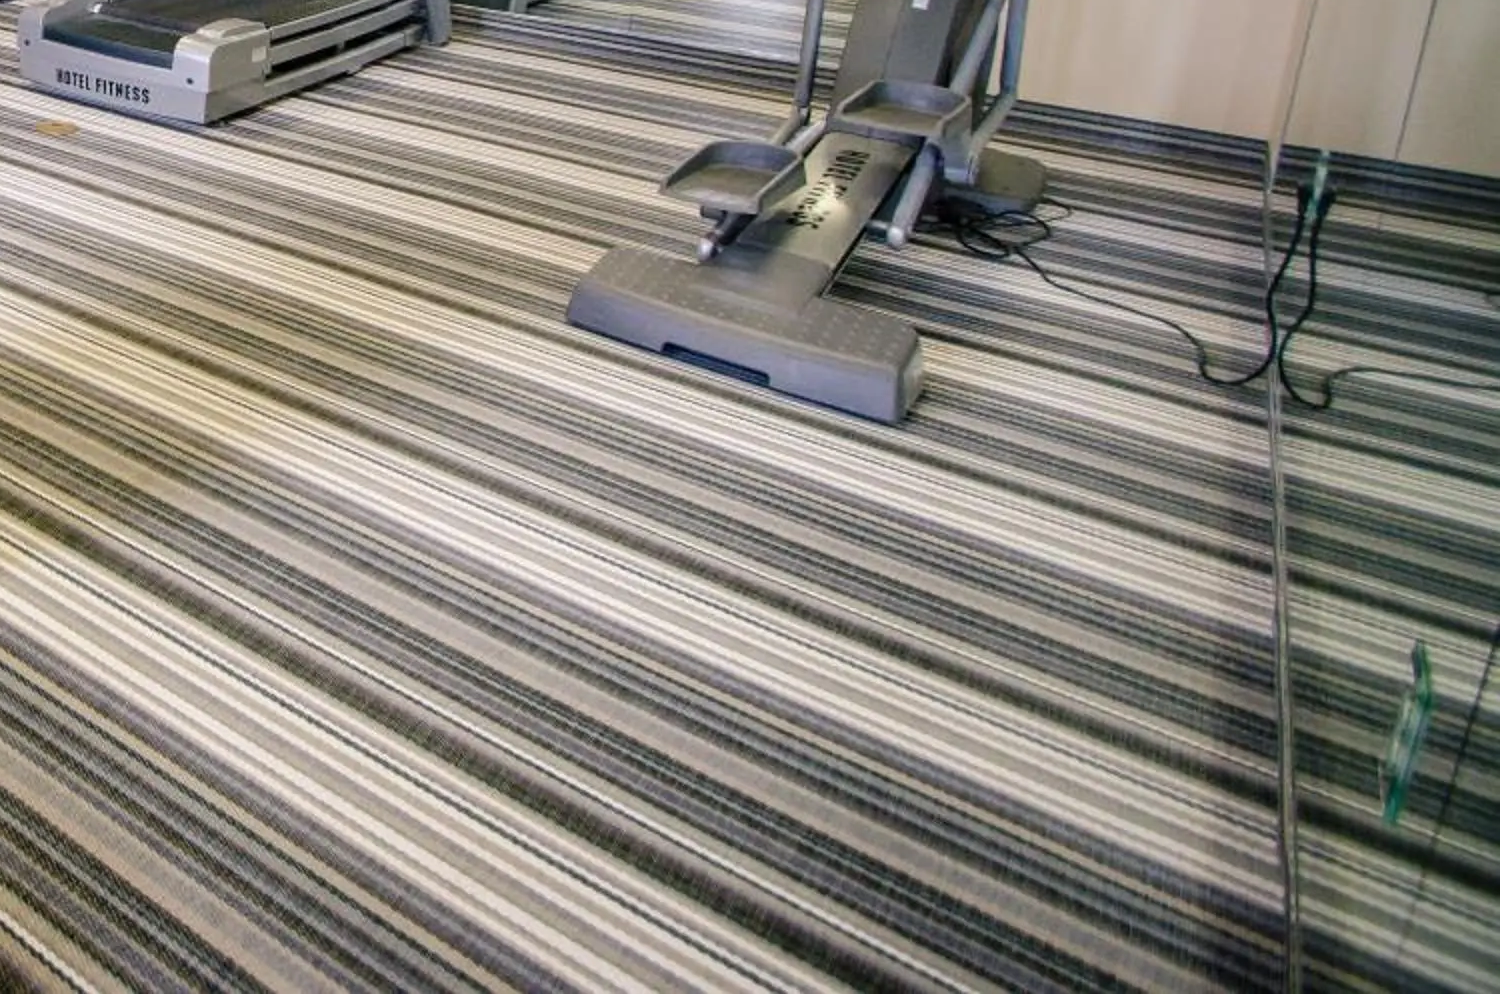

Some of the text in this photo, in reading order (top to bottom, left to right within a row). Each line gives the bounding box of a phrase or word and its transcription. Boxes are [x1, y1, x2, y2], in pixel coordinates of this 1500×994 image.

[55, 68, 150, 104] HOTEL FITNESS
[822, 149, 870, 181] HOTEL
